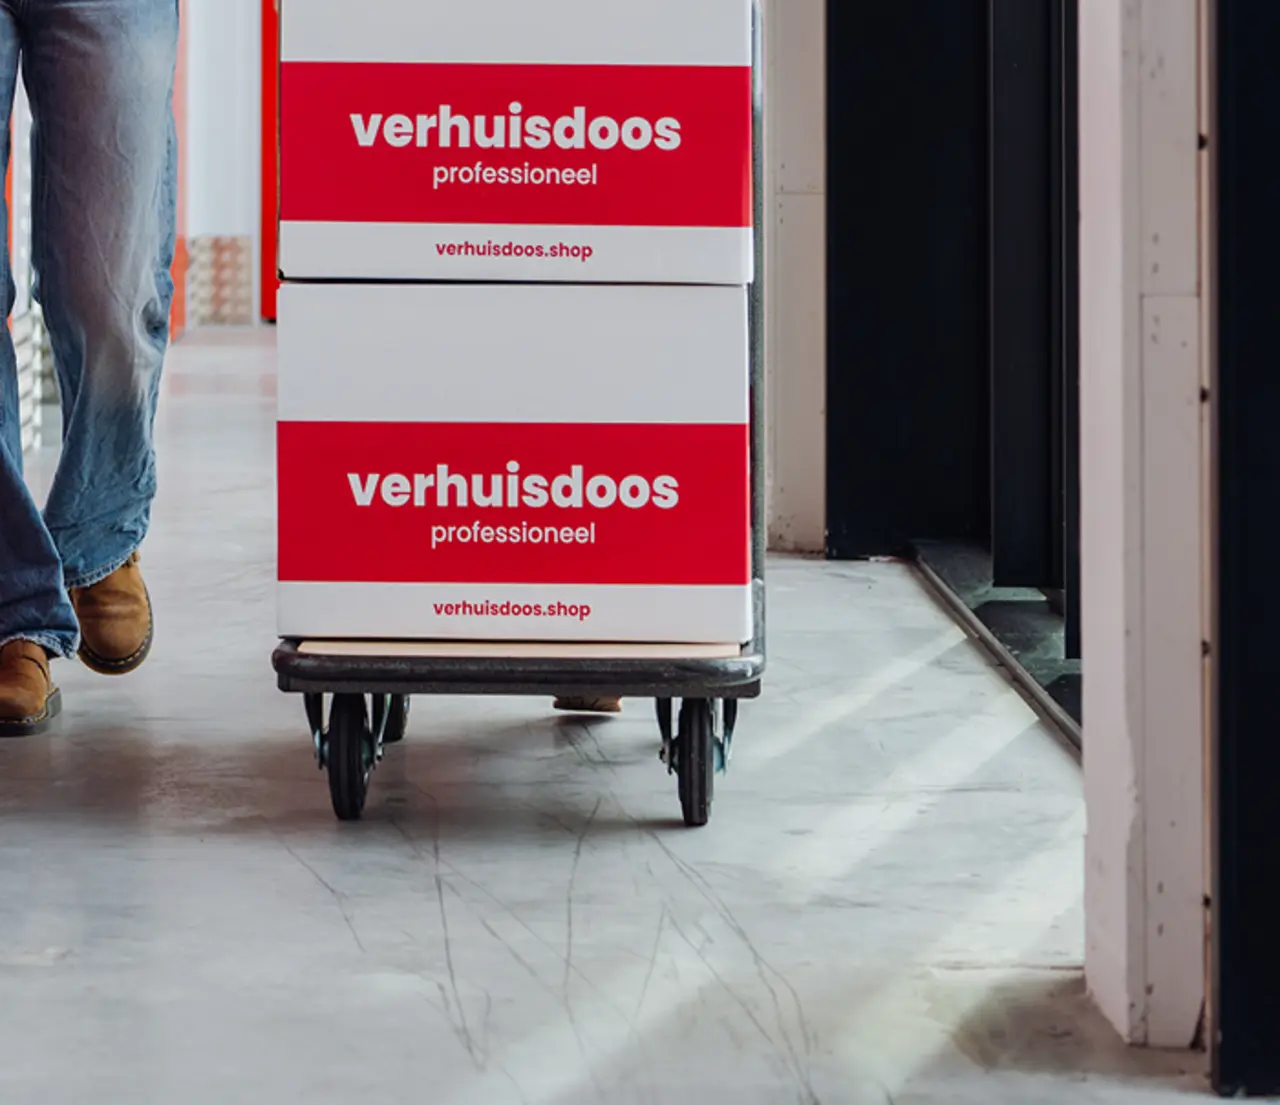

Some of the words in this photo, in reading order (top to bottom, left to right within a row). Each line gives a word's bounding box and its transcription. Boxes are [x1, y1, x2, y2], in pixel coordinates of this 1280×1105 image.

[349, 101, 681, 151] verhuisdoos
[433, 161, 597, 190] professioneel
[435, 240, 593, 262] verhuisdoos.shop
[347, 460, 679, 509] verhuisdoos
[431, 520, 595, 549] professioneel
[433, 599, 591, 621] verhuisdoos.shop
